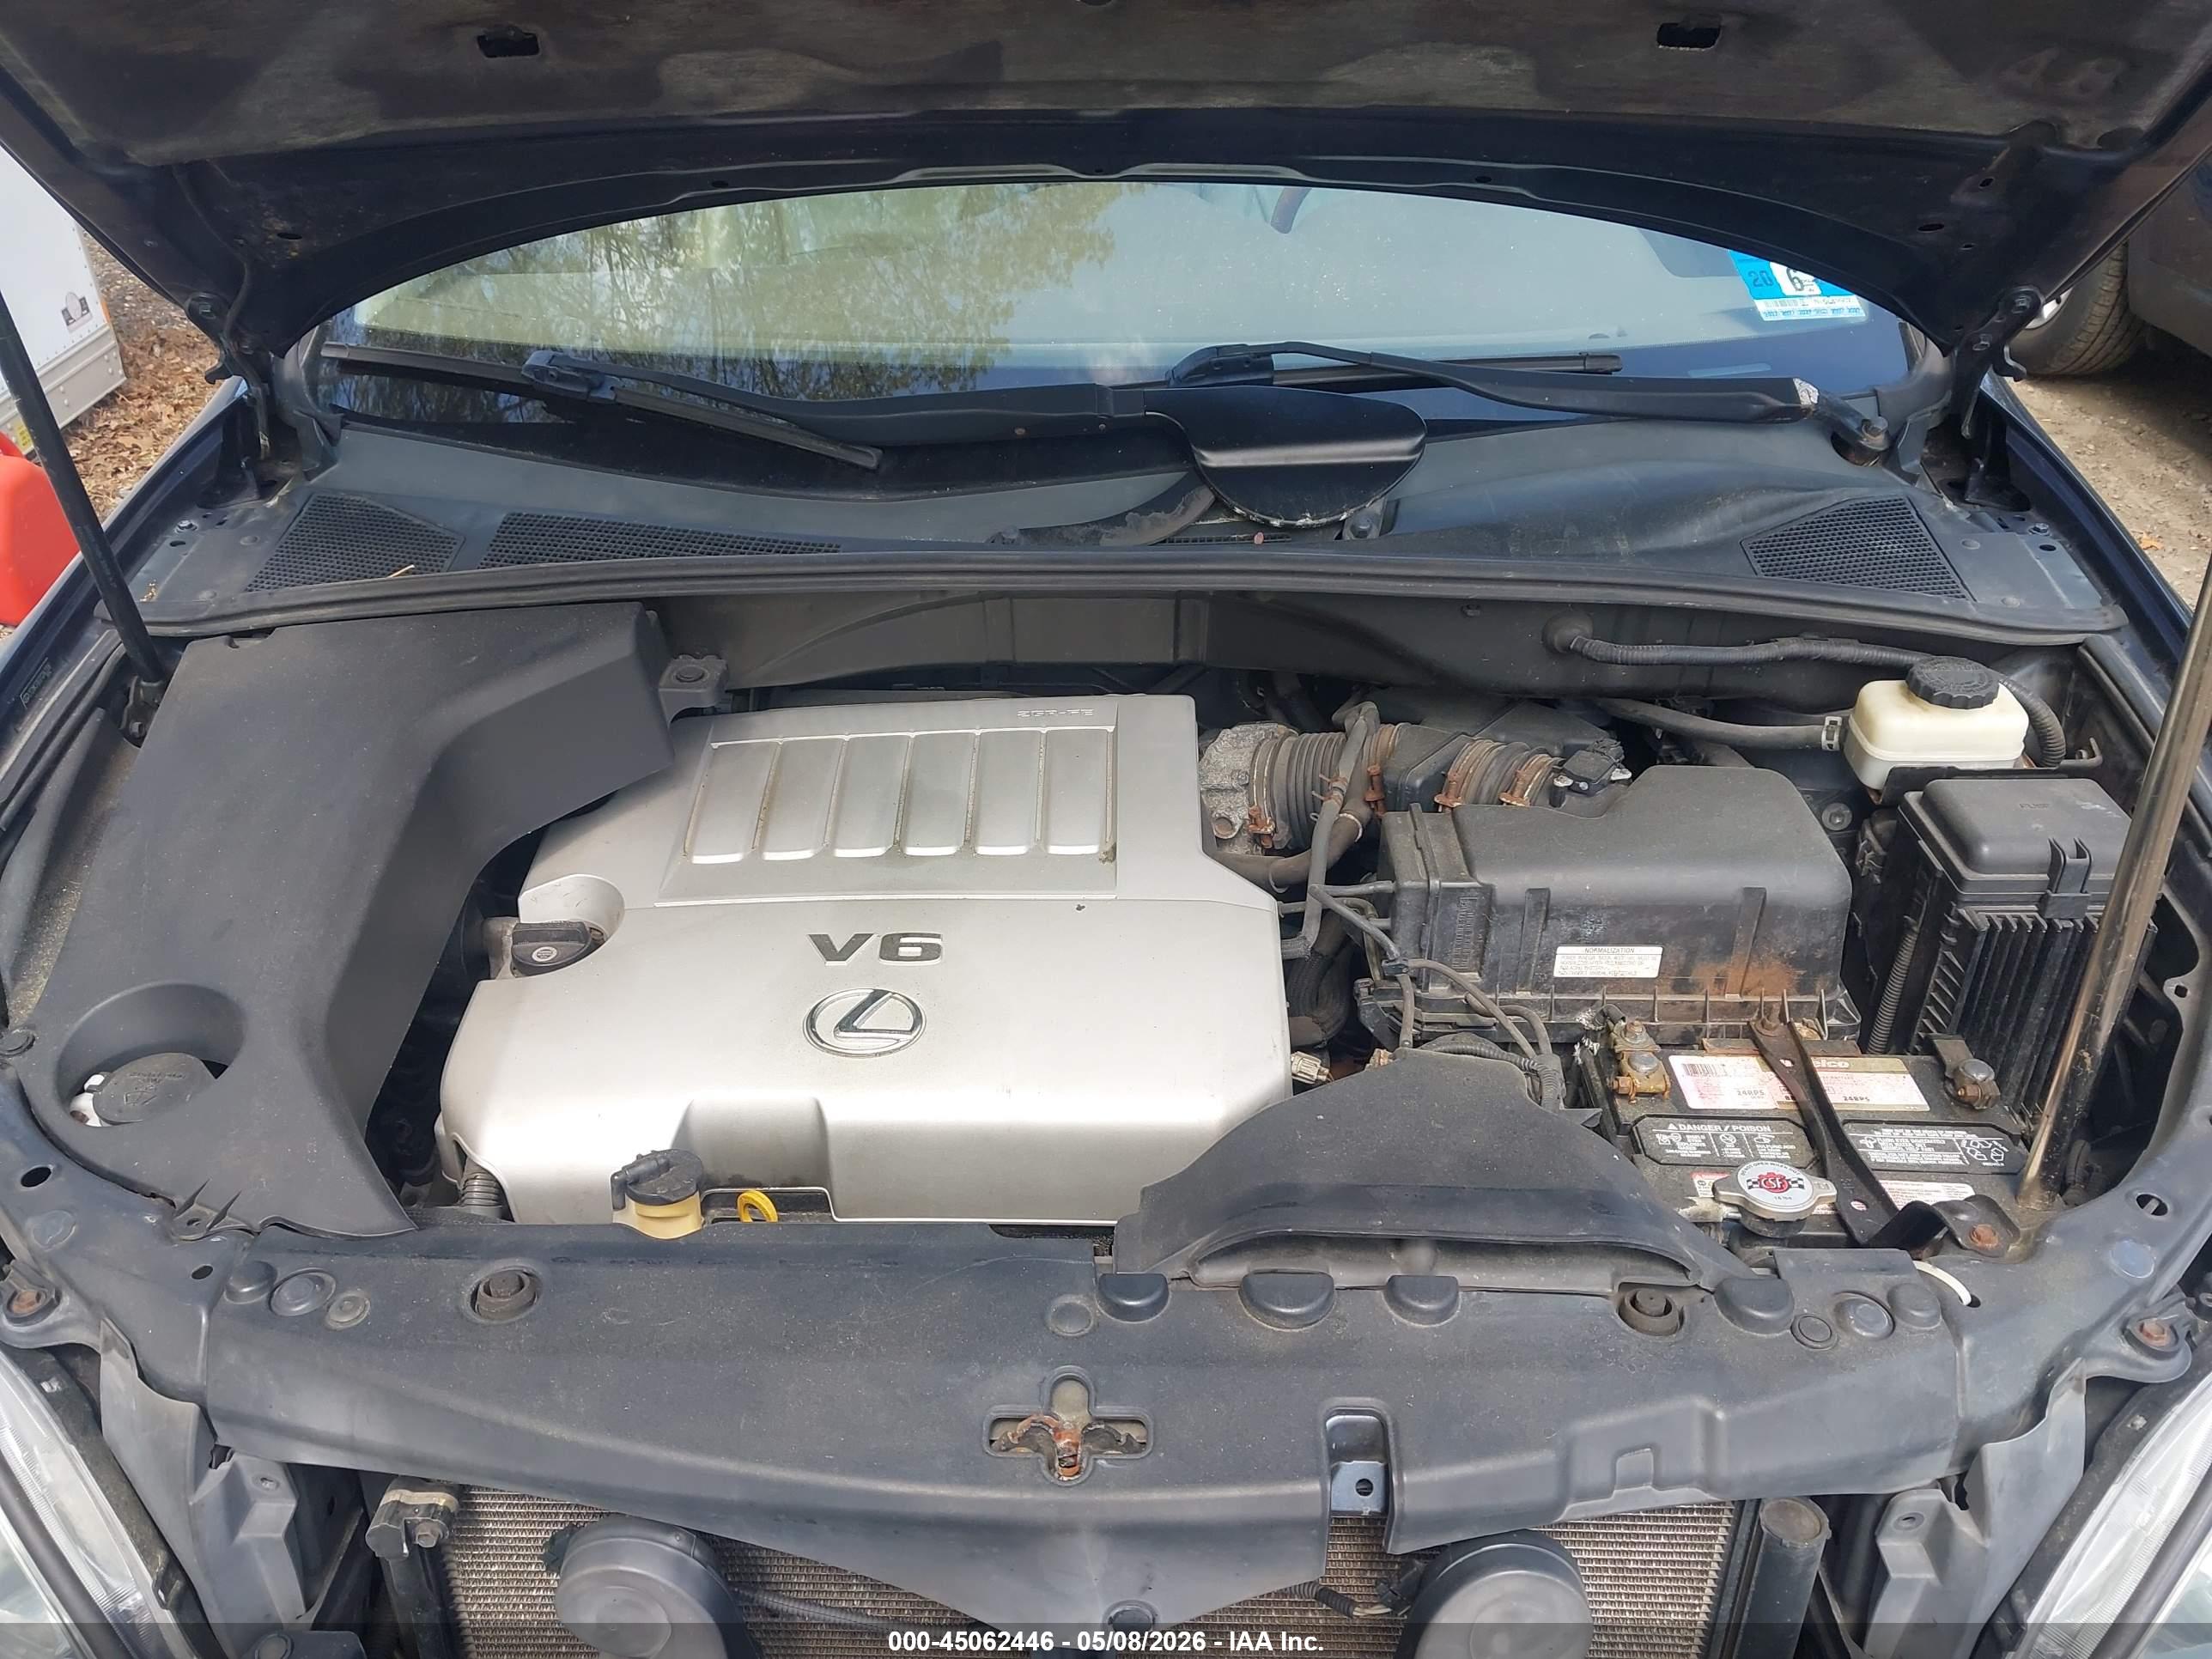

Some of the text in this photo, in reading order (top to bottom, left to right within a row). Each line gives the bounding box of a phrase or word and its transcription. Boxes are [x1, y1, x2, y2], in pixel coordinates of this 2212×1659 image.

[1748, 270, 1773, 287] 20
[806, 932, 943, 967] V6
[1813, 1058, 1850, 1069] elco
[1678, 1123, 1722, 1132] DANGER
[1760, 1177, 1784, 1188] CSF
